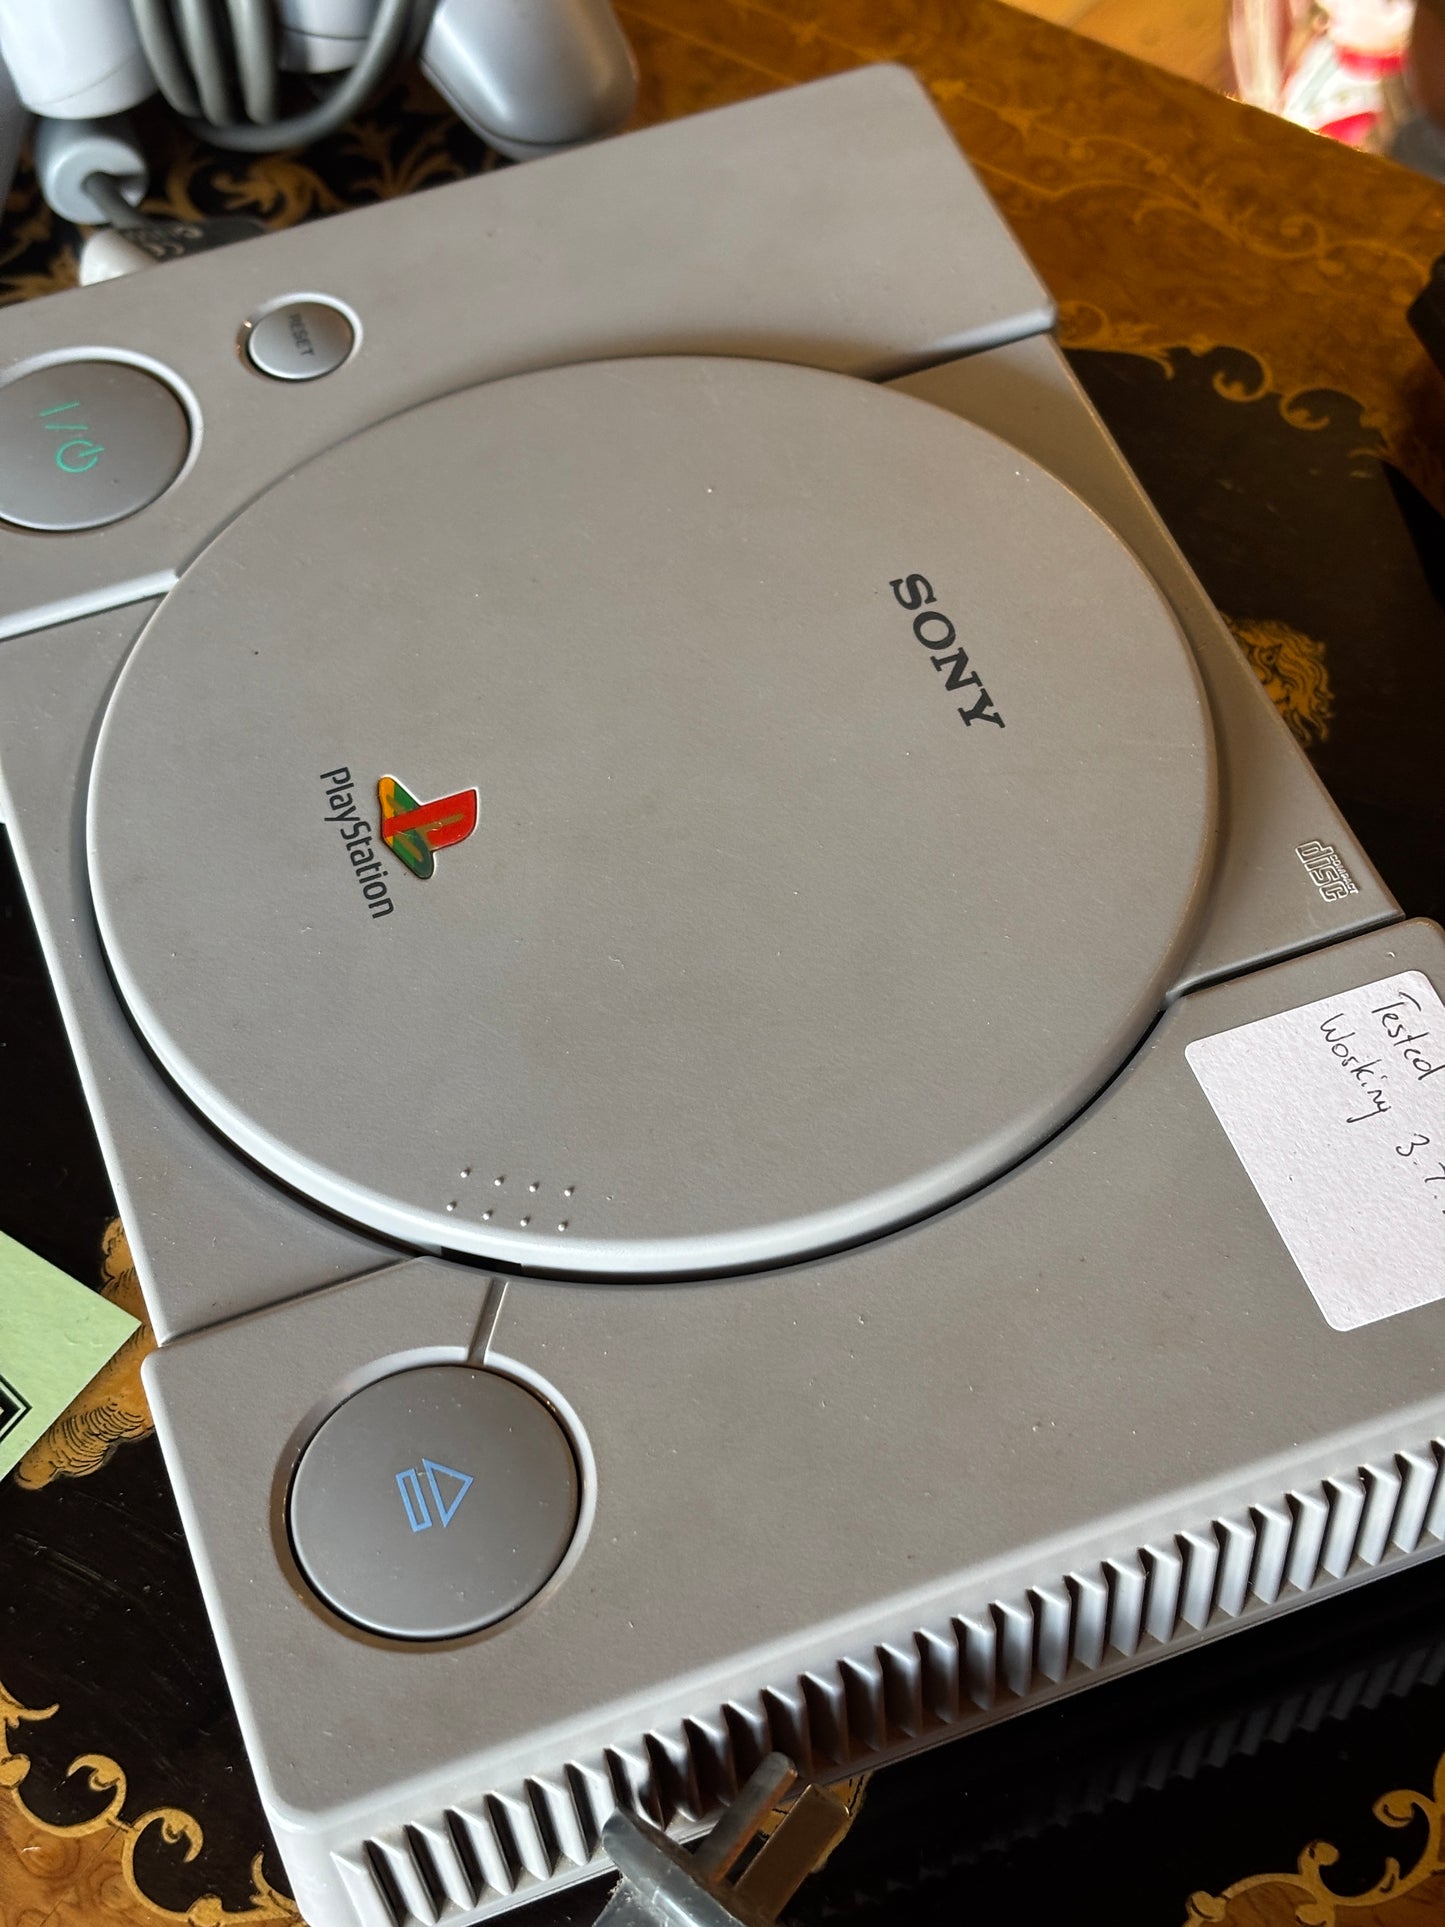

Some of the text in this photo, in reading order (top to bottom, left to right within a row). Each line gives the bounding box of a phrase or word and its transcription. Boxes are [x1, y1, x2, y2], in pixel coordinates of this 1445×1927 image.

[288, 313, 315, 356] RESET
[889, 574, 1006, 729] SONY
[319, 766, 395, 919] PlayStation
[1295, 840, 1349, 903] disc
[1330, 854, 1359, 894] COMPACT
[1371, 987, 1445, 1081] Tested
